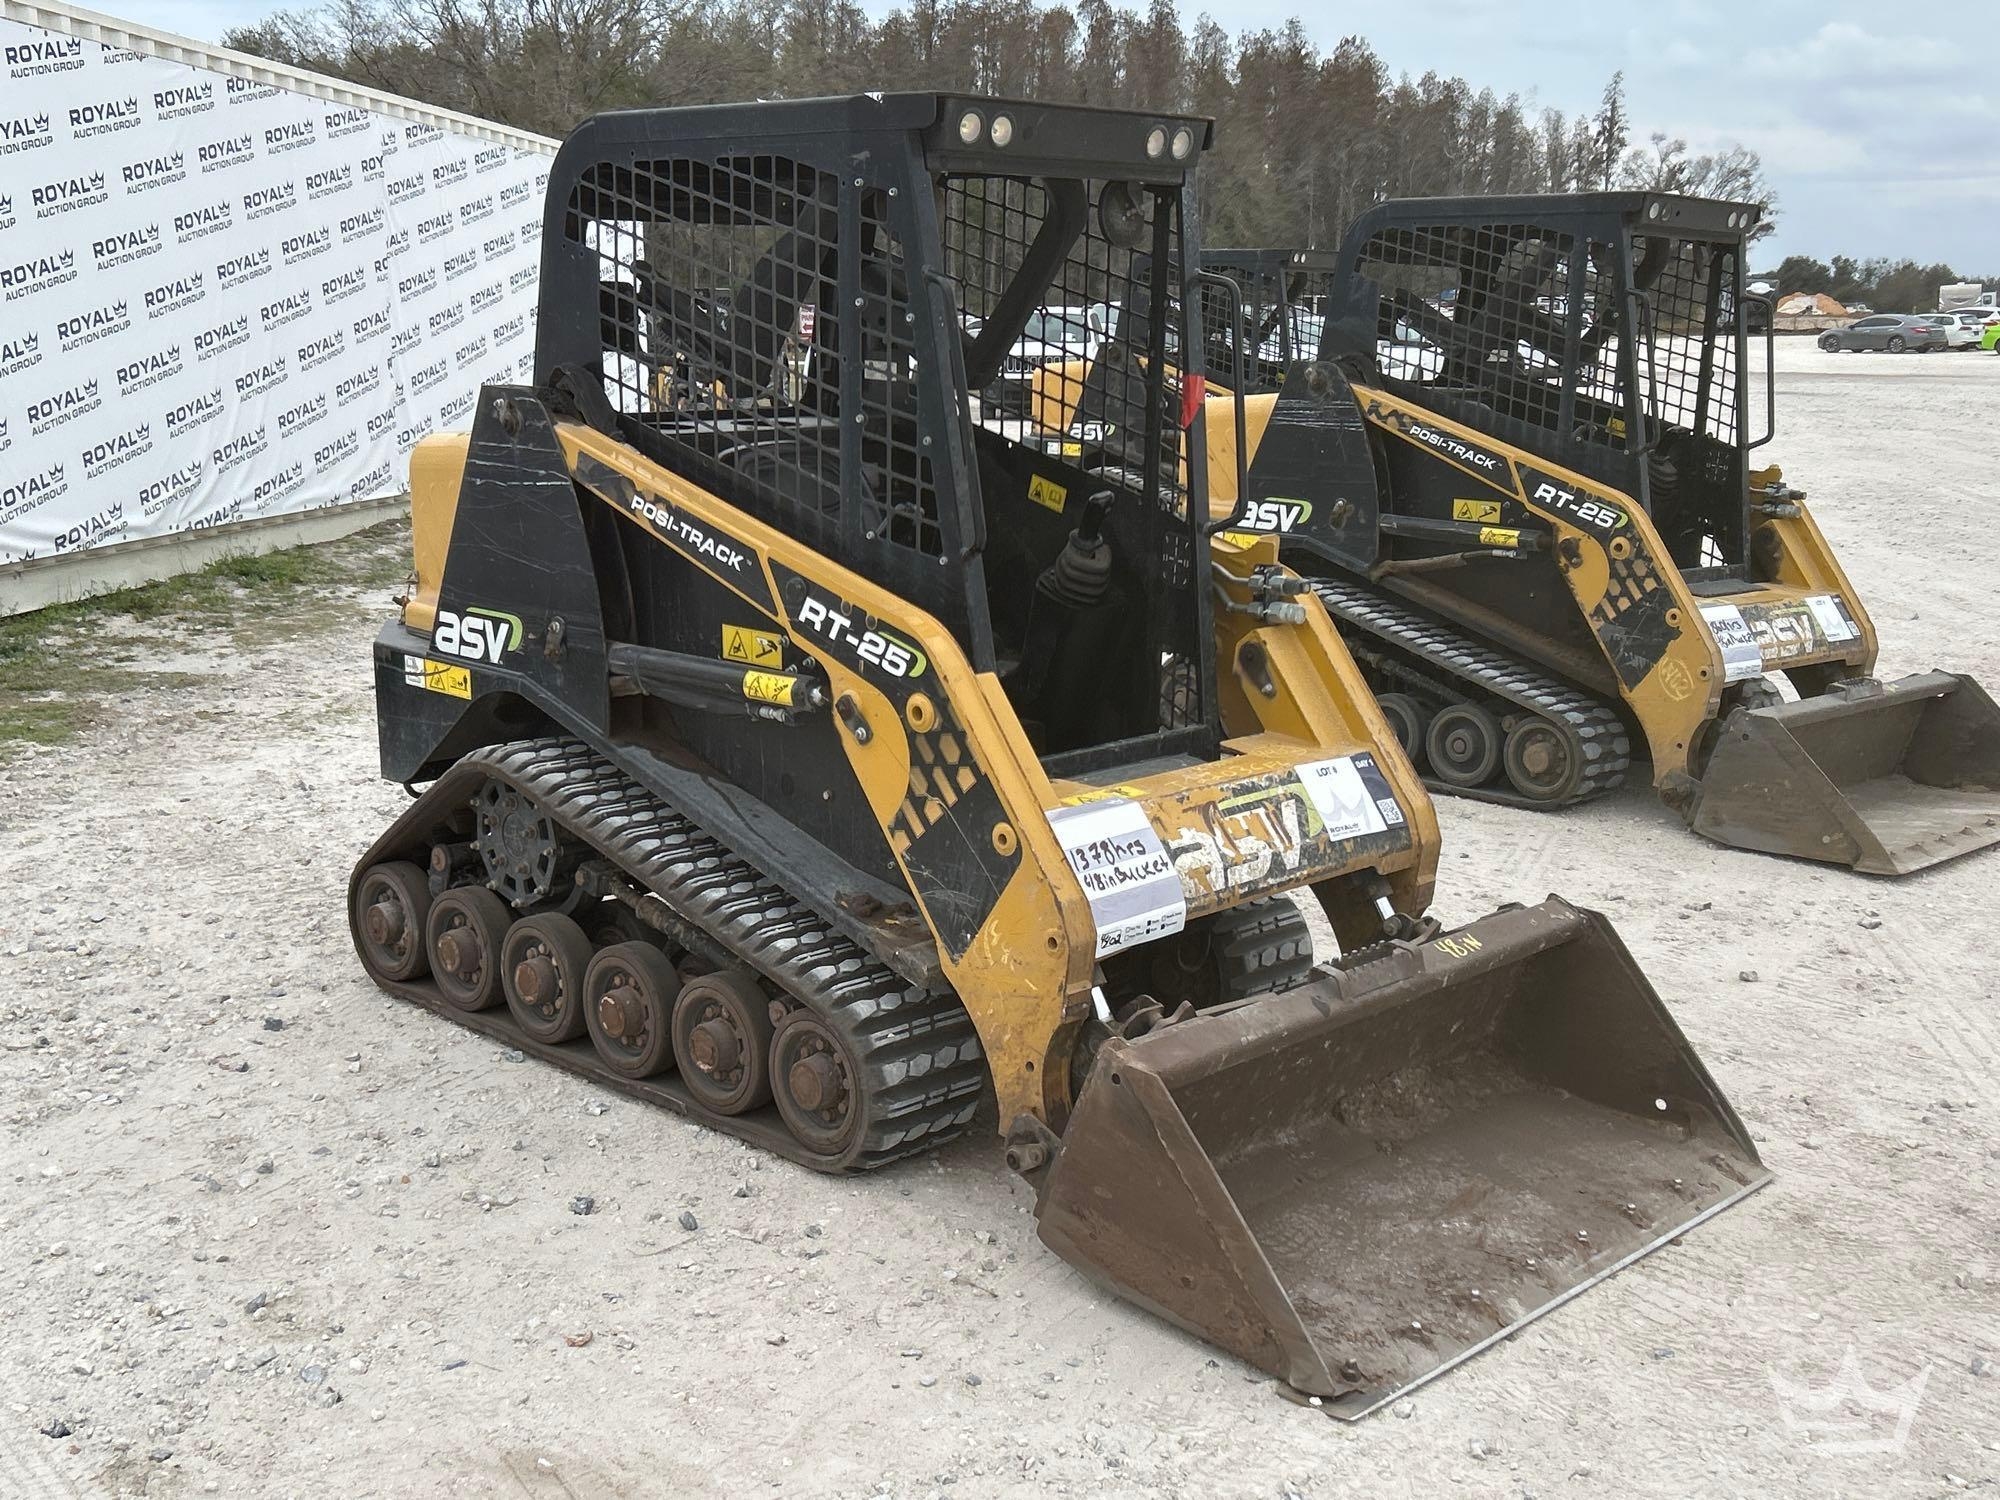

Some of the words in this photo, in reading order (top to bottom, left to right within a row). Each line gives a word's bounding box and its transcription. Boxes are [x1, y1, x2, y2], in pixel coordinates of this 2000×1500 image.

[5, 42, 67, 65] ROYAL
[11, 65, 53, 78] AUCTION
[54, 60, 85, 73] GROUP
[154, 86, 202, 108] ROYAL
[70, 102, 126, 126] ROYAL
[159, 108, 191, 120] AUCTION
[192, 102, 216, 114] GROUP
[326, 109, 360, 129] ROYAL
[75, 125, 113, 139] AUCTION
[114, 118, 142, 131] GROUP
[265, 123, 305, 144] ROYAL
[329, 128, 352, 139] AUCTION
[21, 135, 53, 151] GROUP
[198, 139, 242, 162] ROYAL
[269, 143, 296, 155] AUCTION
[202, 160, 232, 173] AUCTION
[233, 153, 255, 166] GROUP
[475, 148, 500, 166] ROYAL
[122, 157, 173, 182] ROYAL
[306, 169, 343, 190] ROYAL
[31, 178, 91, 206] ROYAL
[127, 180, 161, 194] AUCTION
[162, 172, 187, 185] GROUP
[309, 188, 334, 201] AUCTION
[387, 177, 417, 197] ROYAL
[501, 184, 523, 202] ROYAL
[37, 202, 77, 219] AUCTION
[78, 193, 108, 208] GROUP
[243, 186, 285, 210] ROYAL
[461, 199, 486, 218] ROYAL
[174, 207, 220, 232] ROYAL
[247, 207, 275, 220] AUCTION
[340, 212, 374, 234] ROYAL
[418, 215, 447, 236] ROYAL
[178, 228, 209, 244] AUCTION
[210, 220, 233, 234] GROUP
[282, 231, 321, 256] ROYAL
[343, 230, 366, 243] AUCTION
[93, 230, 148, 259] ROYAL
[484, 235, 509, 254] ROYAL
[98, 253, 135, 271] AUCTION
[136, 243, 163, 259] GROUP
[217, 254, 260, 280] ROYAL
[285, 251, 312, 266] AUCTION
[445, 253, 470, 273] ROYAL
[1, 257, 60, 288] ROYAL
[221, 274, 250, 290] AUCTION
[251, 265, 272, 279] GROUP
[322, 272, 356, 296] ROYAL
[399, 272, 429, 294] ROYAL
[510, 268, 532, 286] ROYAL
[7, 282, 47, 301] AUCTION
[48, 271, 77, 288] GROUP
[145, 279, 192, 307] ROYAL
[470, 287, 496, 307] ROYAL
[150, 302, 181, 319] AUCTION
[182, 291, 206, 307] GROUP
[261, 296, 300, 322] ROYAL
[326, 291, 348, 306] AUCTION
[56, 308, 114, 340] ROYAL
[265, 316, 291, 332] AUCTION
[354, 311, 388, 335] ROYAL
[429, 307, 457, 328] ROYAL
[494, 319, 518, 339] ROYAL
[62, 332, 101, 353] AUCTION
[102, 320, 131, 338] GROUP
[194, 322, 238, 351] ROYAL
[198, 344, 228, 362] AUCTION
[229, 333, 251, 349] GROUP
[299, 336, 336, 363] ROYAL
[456, 341, 480, 362] ROYAL
[11, 353, 42, 374] GROUP
[117, 353, 169, 385] ROYAL
[302, 356, 327, 372] AUCTION
[122, 376, 157, 397] AUCTION
[158, 364, 184, 381] GROUP
[236, 364, 277, 393] ROYAL
[240, 385, 267, 403] AUCTION
[268, 373, 289, 389] GROUP
[336, 372, 370, 398] ROYAL
[411, 365, 440, 387] ROYAL
[27, 388, 85, 423] ROYAL
[339, 391, 362, 407] AUCTION
[441, 396, 468, 418] ROYAL
[33, 413, 72, 436] AUCTION
[73, 399, 102, 418] GROUP
[166, 396, 212, 428] ROYAL
[170, 418, 202, 439] AUCTION
[202, 406, 226, 423] GROUP
[278, 400, 317, 430] ROYAL
[282, 421, 308, 439] AUCTION
[82, 432, 137, 468] ROYAL
[247, 442, 269, 459] GROUP
[314, 436, 349, 465] ROYAL
[1409, 423, 1497, 471] POSI-TRACK
[87, 456, 125, 480] AUCTION
[126, 442, 153, 461] GROUP
[317, 456, 341, 476] AUCTION
[139, 470, 190, 506] ROYAL
[254, 470, 293, 502] ROYAL
[351, 467, 383, 496] ROYAL
[37, 483, 68, 507] GROUP
[258, 491, 284, 511] AUCTION
[285, 478, 305, 495] GROUP
[1534, 482, 1618, 529] RT-25
[55, 512, 110, 552] ROYAL
[98, 521, 129, 544] GROUP
[630, 494, 744, 572] POSI-TRACK
[798, 596, 912, 678] RT-25
